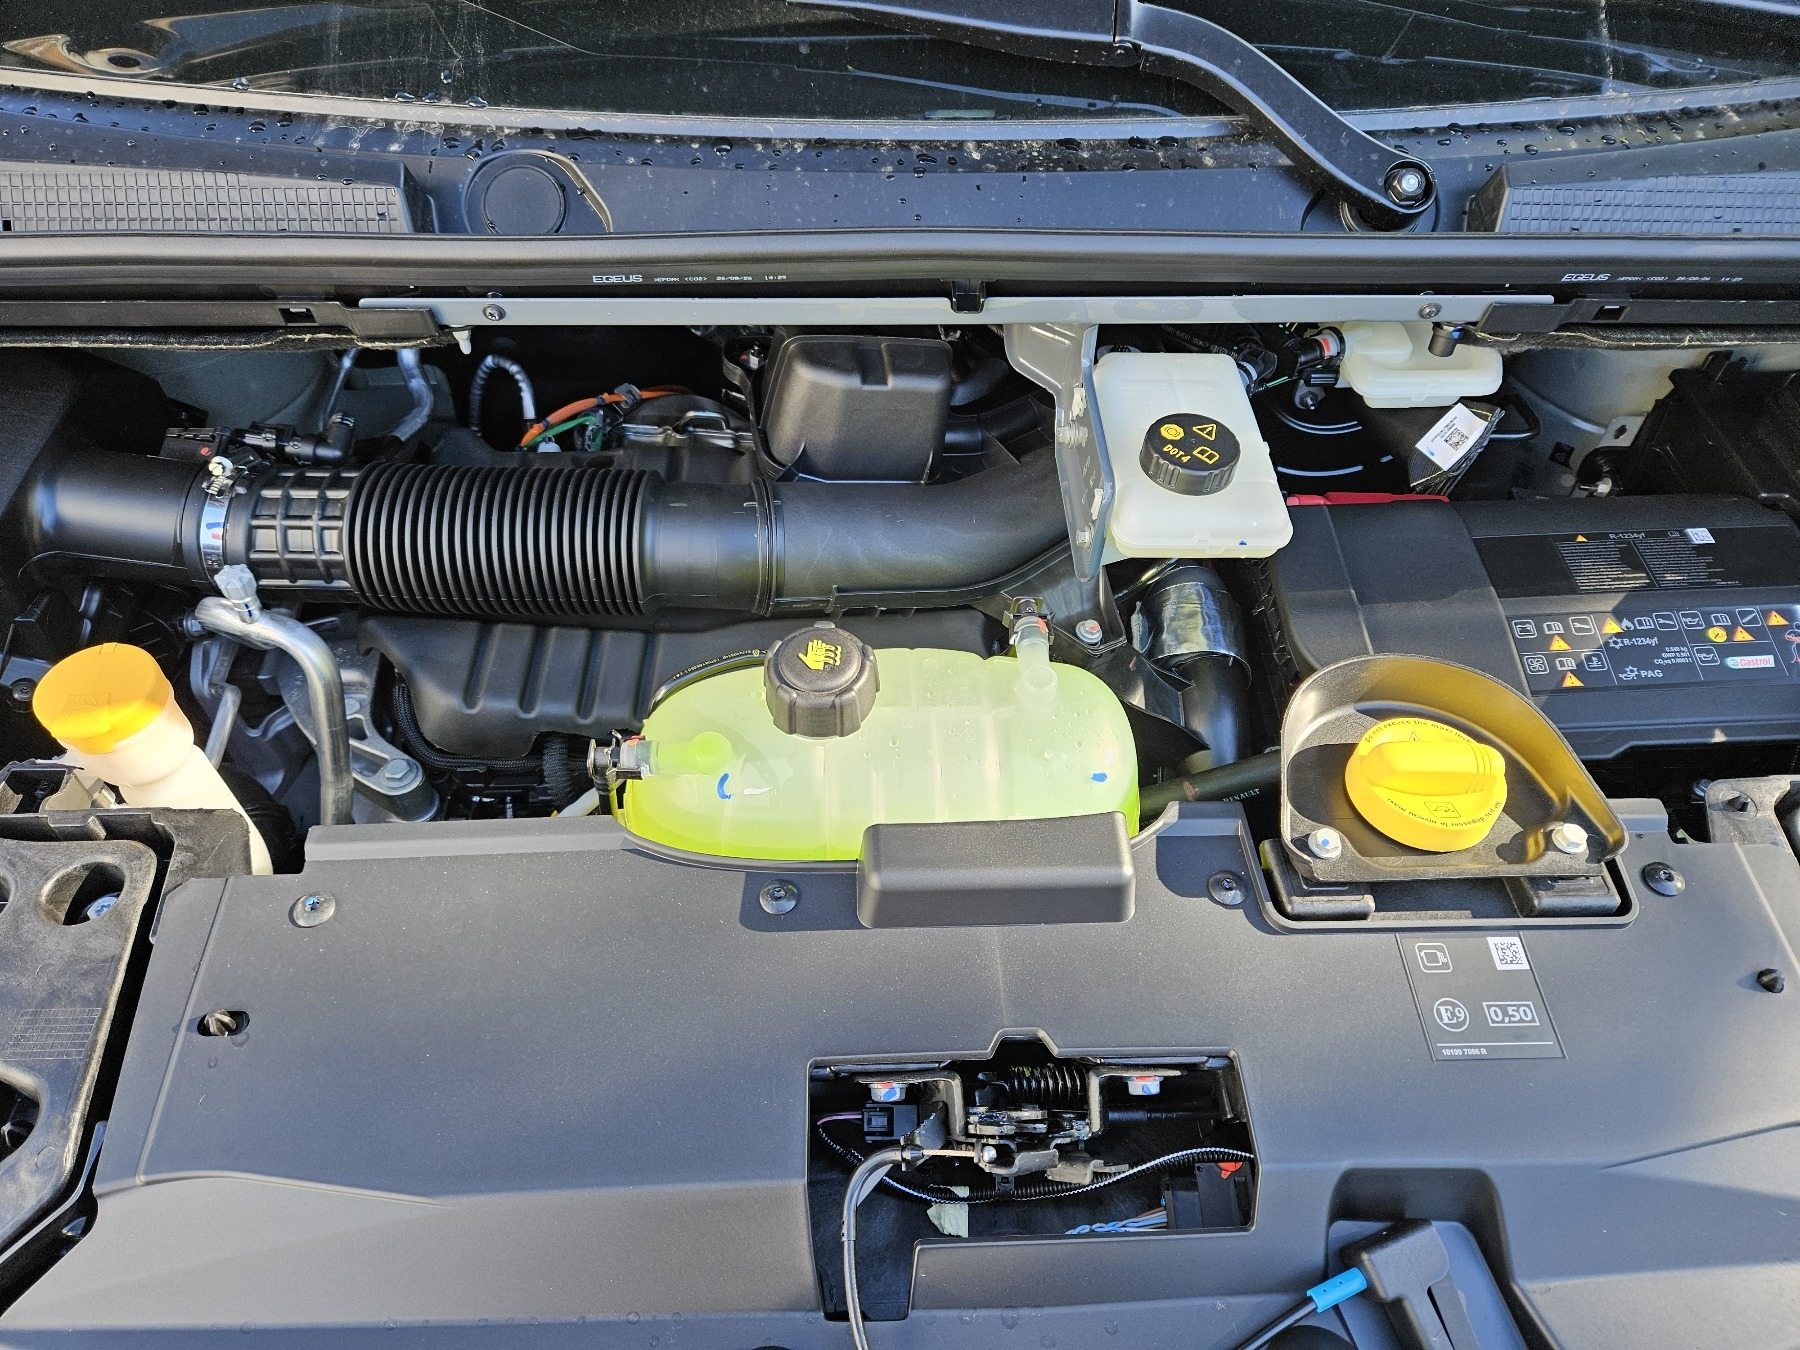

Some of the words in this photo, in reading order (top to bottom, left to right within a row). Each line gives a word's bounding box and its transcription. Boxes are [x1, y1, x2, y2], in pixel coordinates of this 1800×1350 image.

[592, 275, 643, 283] EGEUS
[1561, 273, 1611, 282] EGEUS
[1623, 636, 1659, 647] R-1234yf
[1739, 657, 1773, 668] Castrol
[1640, 670, 1663, 679] PAG
[1222, 788, 1260, 803] RENAULT
[1438, 1006, 1465, 1024] E9
[1489, 1006, 1533, 1023] 0,50
[1480, 1048, 1488, 1056] R
